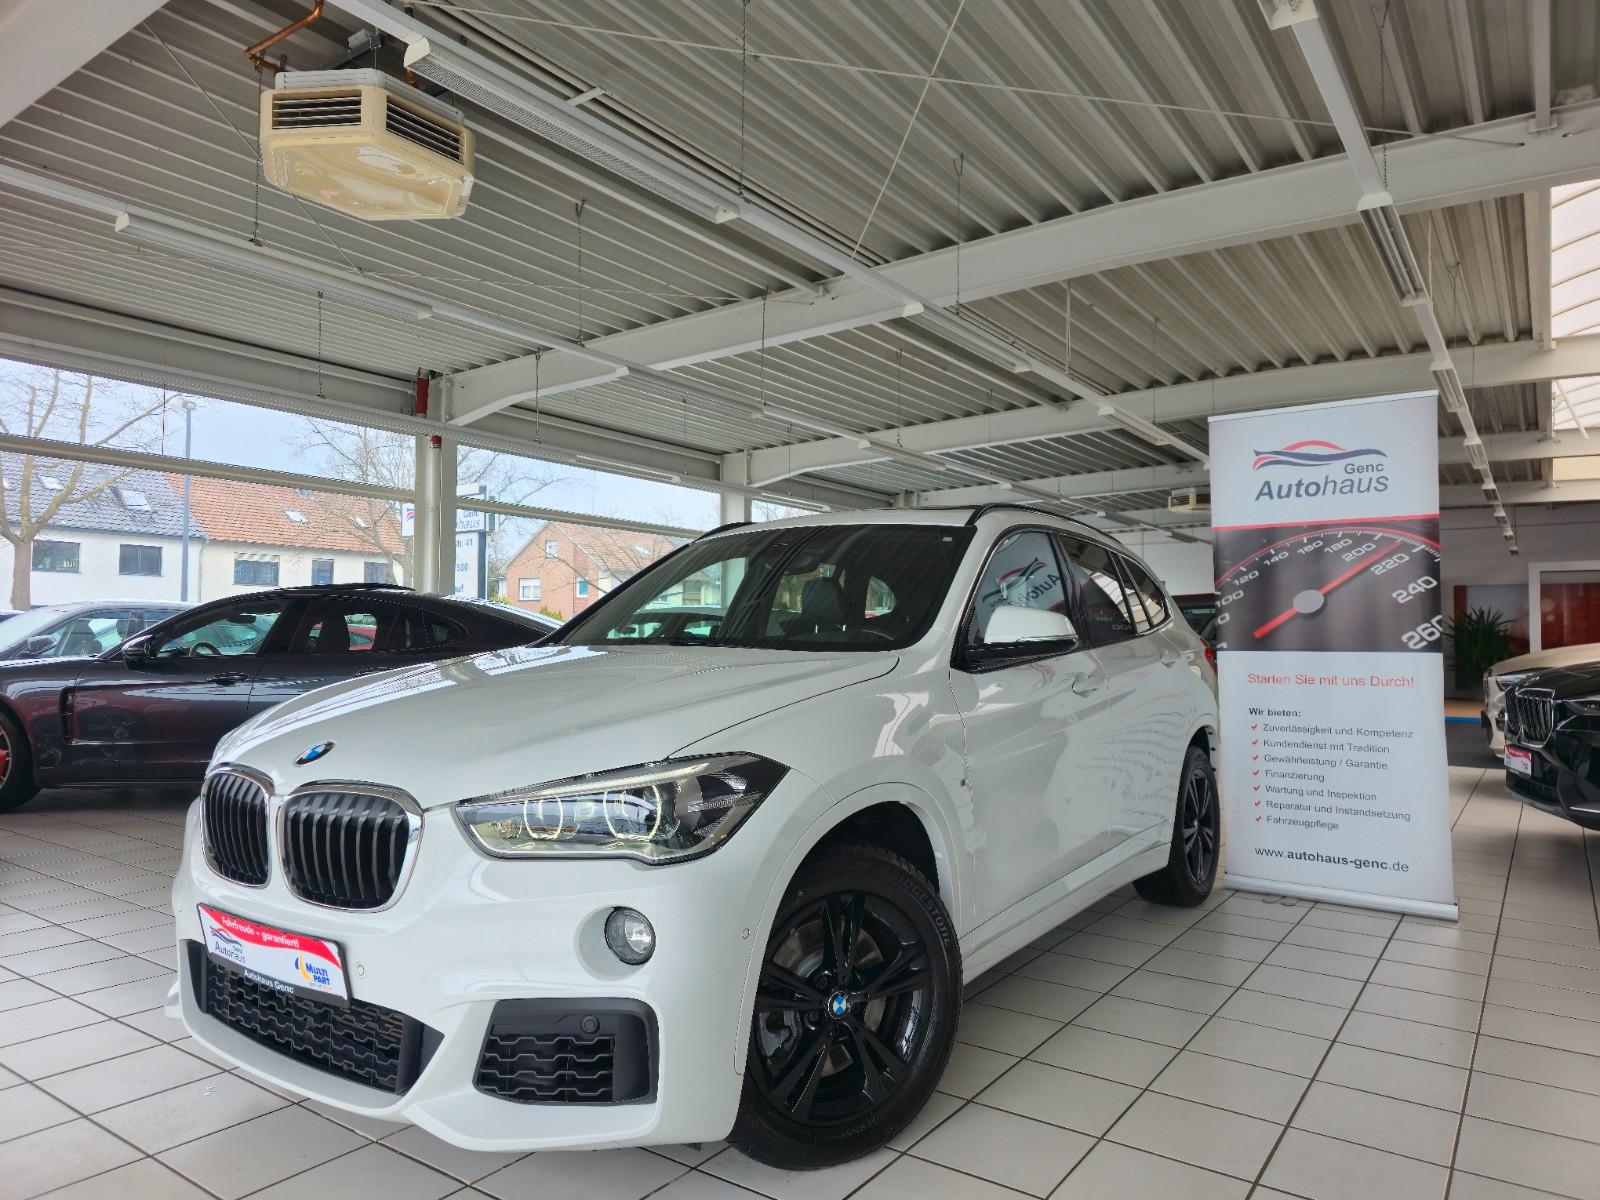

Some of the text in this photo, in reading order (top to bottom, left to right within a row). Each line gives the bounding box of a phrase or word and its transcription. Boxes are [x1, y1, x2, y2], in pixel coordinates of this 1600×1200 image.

[1344, 462, 1385, 475] Genc
[1255, 474, 1390, 501] Autohaus
[1296, 539, 1325, 556] 160
[1323, 537, 1353, 554] 180
[1341, 542, 1377, 563] 200
[1263, 551, 1289, 566] 140
[1370, 553, 1411, 576] 220
[1232, 570, 1260, 586] 120
[1391, 575, 1438, 604] 240
[1215, 589, 1245, 608] 100
[1247, 673, 1414, 688] Starten Sie mit uns Durch!
[1248, 707, 1302, 717] Wir bieten:
[1262, 723, 1414, 739] Zuverlässigkeit und Kompetenz
[1263, 738, 1390, 754] Kundendienst mit Tradition
[1264, 754, 1337, 768] Gewährleistung
[1345, 758, 1388, 770] Garantie
[1264, 769, 1325, 783] Finanzierung
[1265, 784, 1377, 801] Wartung und Inspektion
[1266, 800, 1411, 822] Reparatur und Instandsetzung
[1266, 815, 1339, 831] Fahrzeugpflege
[1254, 847, 1410, 873] www.autohaus-genc.de
[274, 980, 295, 994] Genc
[312, 974, 330, 986] PART
